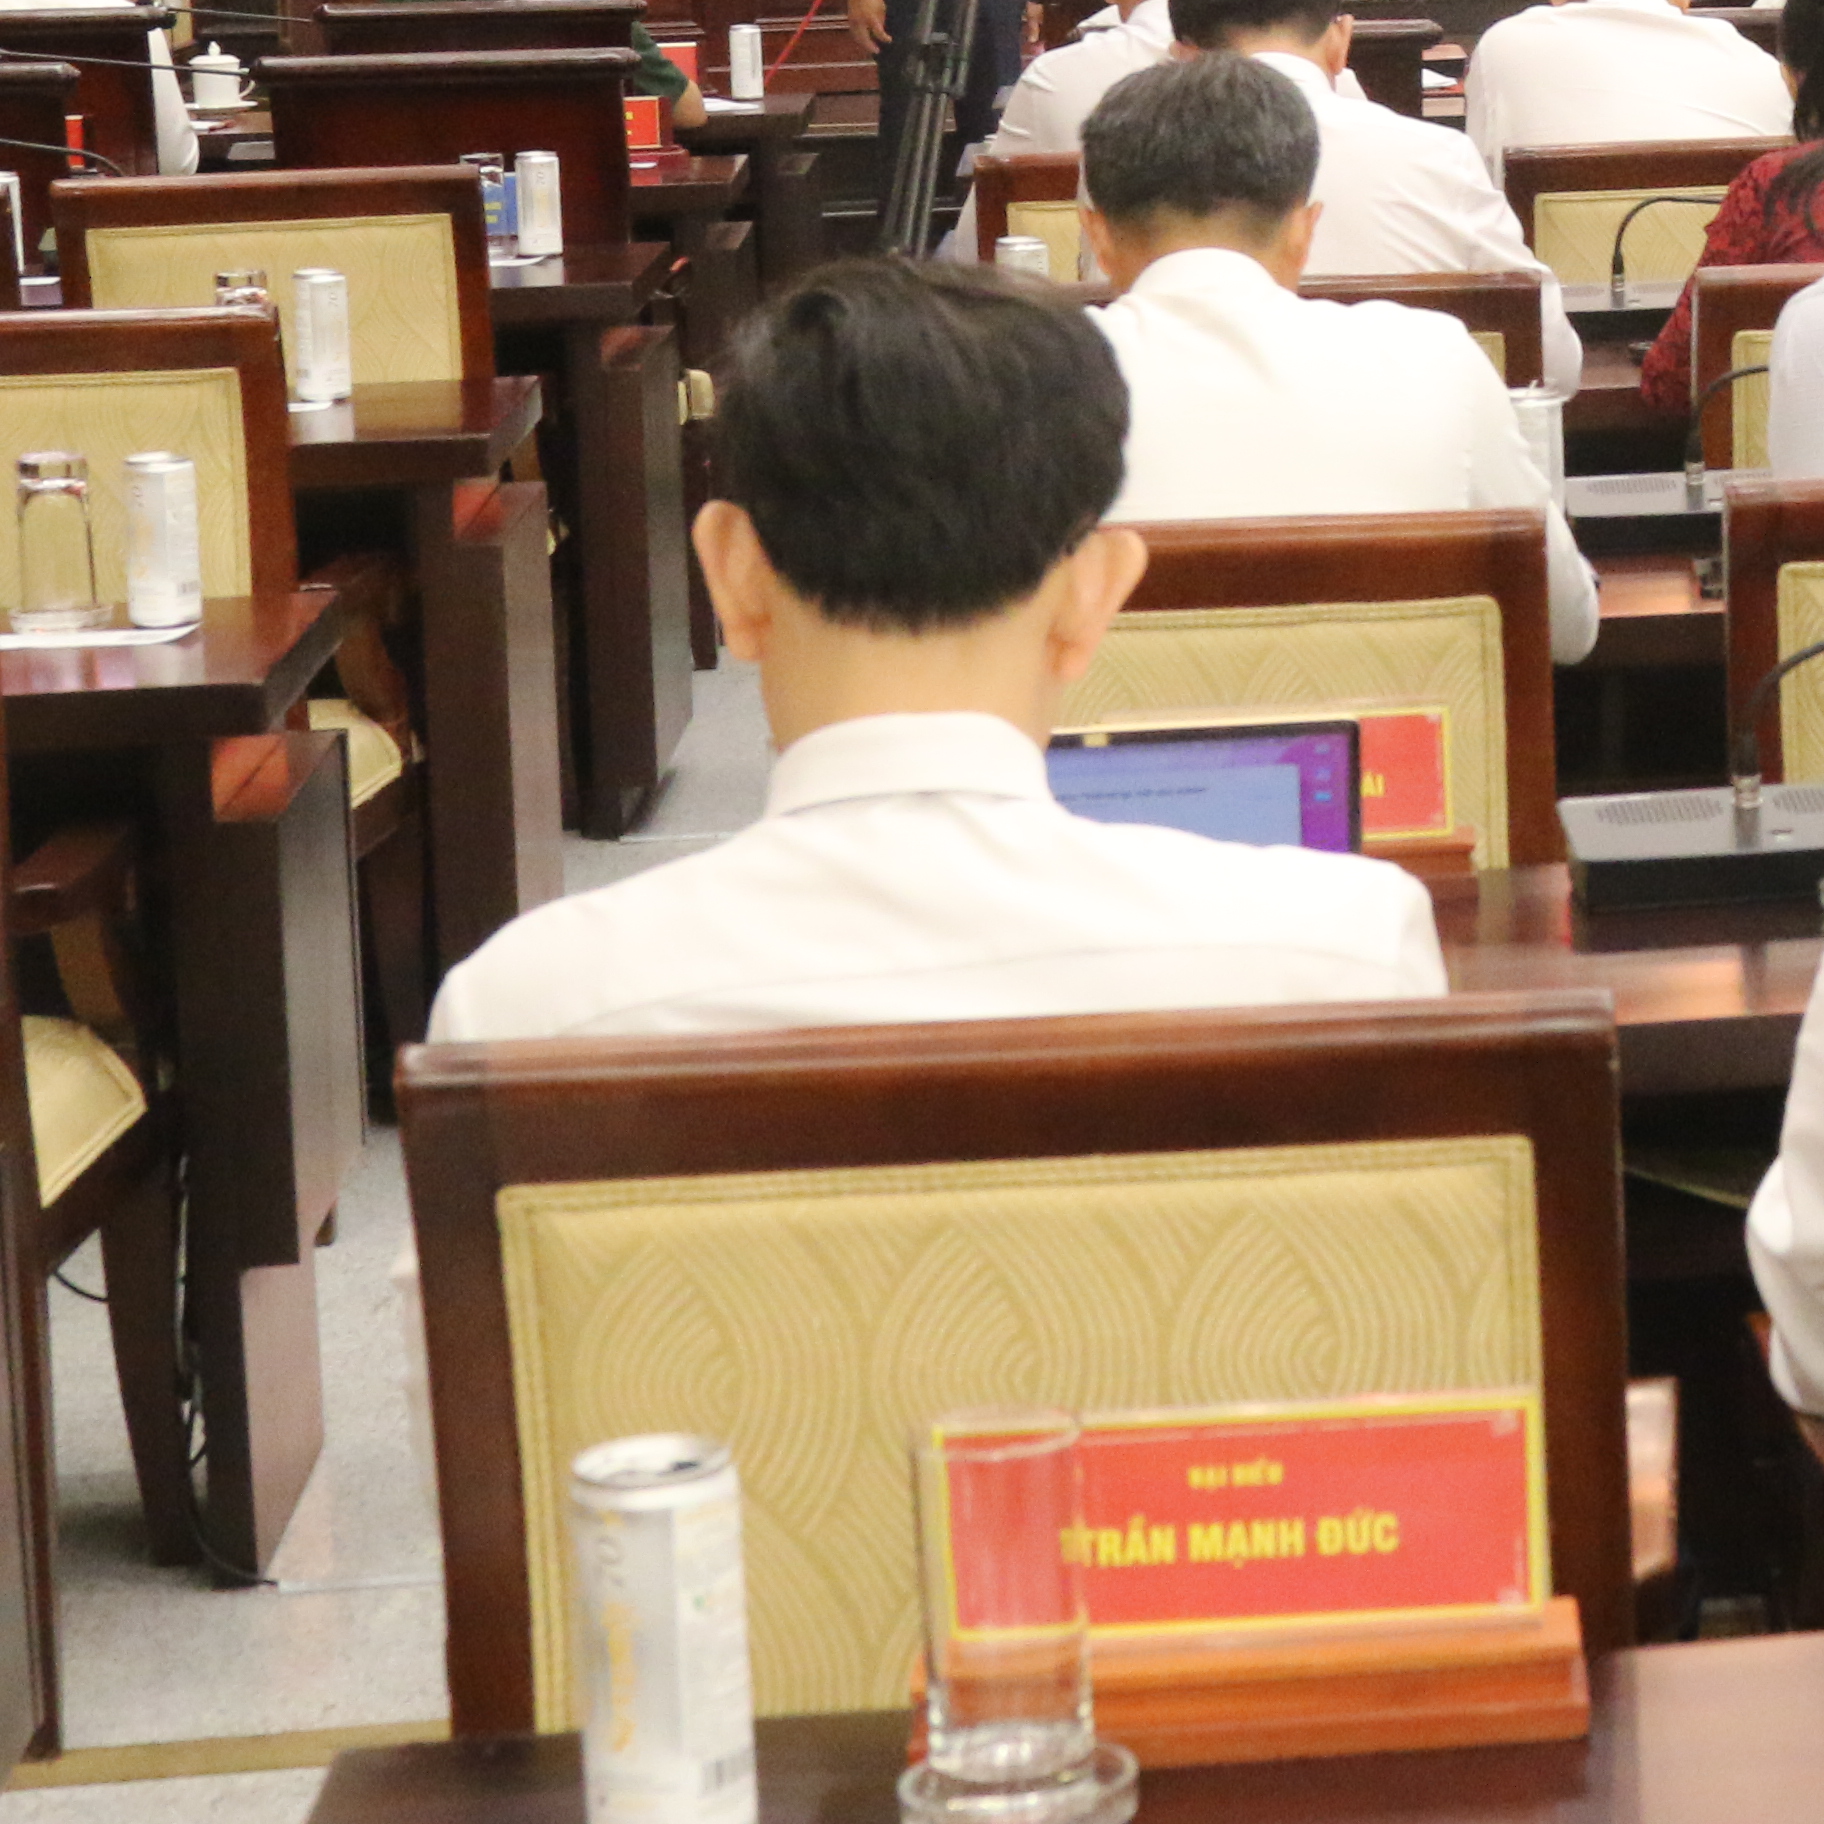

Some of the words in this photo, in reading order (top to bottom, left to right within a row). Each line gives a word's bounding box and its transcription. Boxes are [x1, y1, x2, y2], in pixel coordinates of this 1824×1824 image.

[1078, 1512, 1177, 1568] TRẦN
[1186, 1516, 1306, 1570] MẠNH
[1313, 1505, 1400, 1557] ĐỨC
